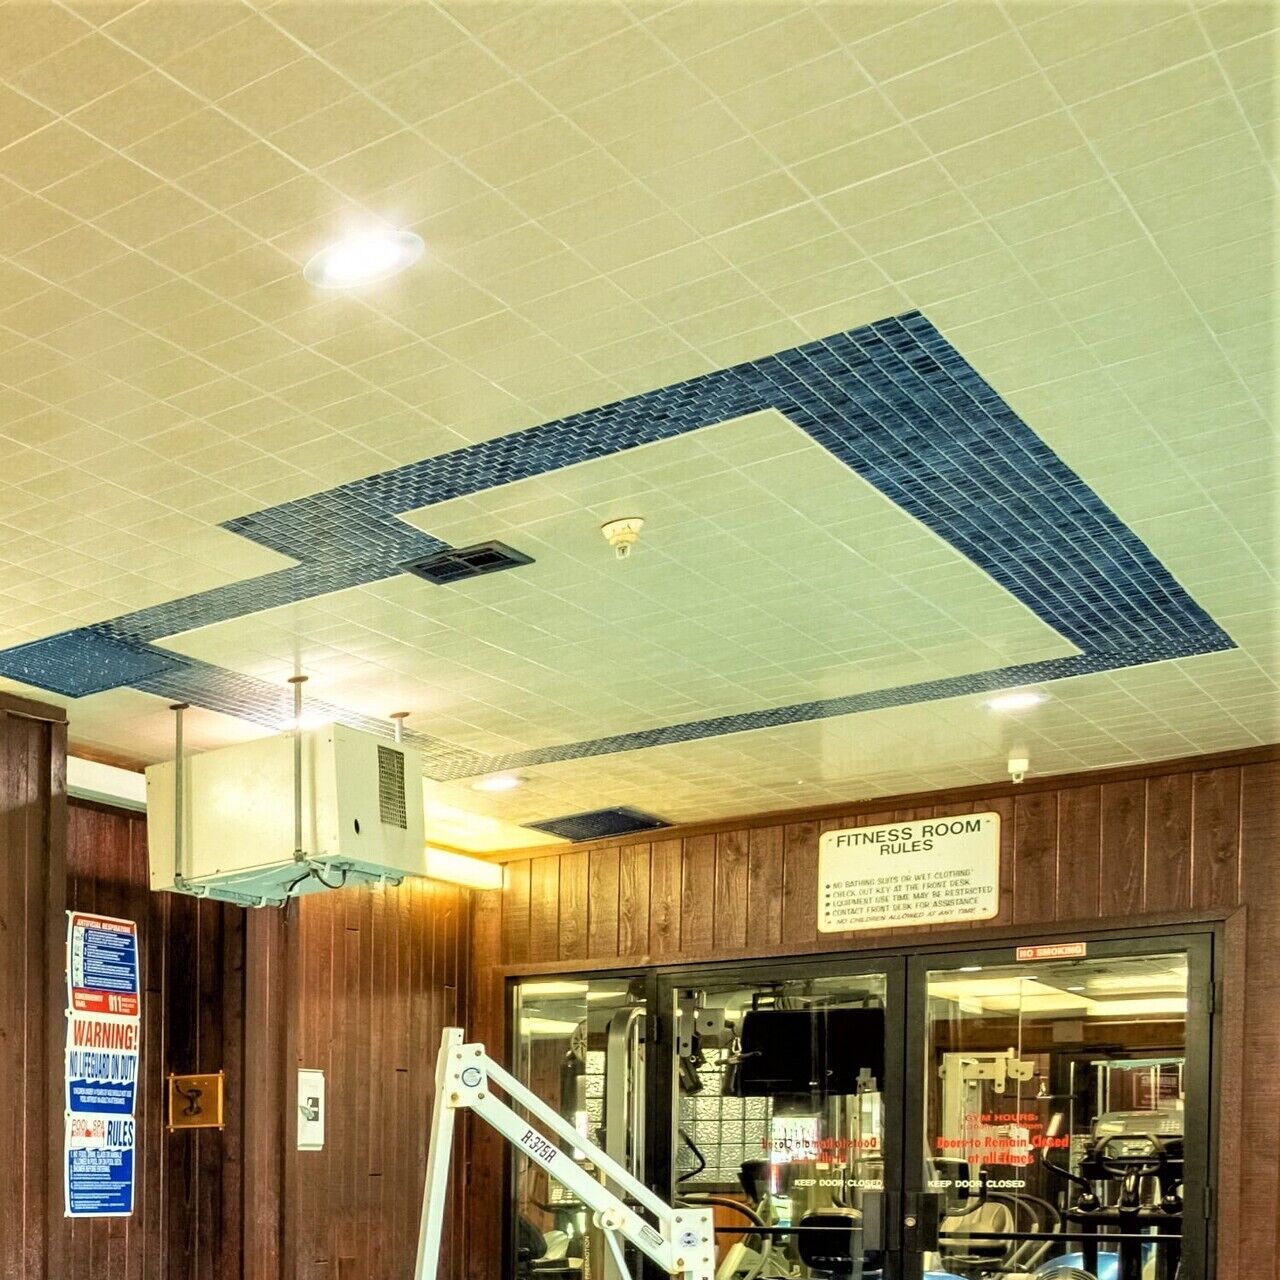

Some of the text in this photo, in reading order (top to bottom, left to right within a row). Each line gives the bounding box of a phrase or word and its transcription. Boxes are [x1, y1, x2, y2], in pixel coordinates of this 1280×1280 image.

[836, 819, 981, 848] FITNESS ROOM
[880, 839, 934, 856] RULES
[845, 879, 875, 888] BATHING
[877, 876, 898, 885] SUITS
[914, 873, 931, 881] WET
[934, 869, 971, 879] CLOTHING
[833, 890, 856, 898] CHECK
[859, 888, 873, 896] OUT
[876, 886, 890, 894] KEY
[922, 881, 947, 890] FRONT
[950, 879, 970, 887] DESK
[833, 886, 993, 907] EQUIPMENT USE TIME MAY BE RESTRICTED
[833, 897, 978, 916] CONTACT FRONT DESK FOR ASSISTANCE
[1019, 945, 1082, 958] NO SMOKING
[73, 1019, 138, 1051] WARNING!
[69, 1050, 137, 1081] NO LIFEGUARD ON DUTY
[106, 1120, 134, 1147] RULES
[984, 1135, 1027, 1149] Remain
[1032, 1134, 1069, 1149] Closed
[794, 1179, 883, 1188] KEEP DOOR CLOSED
[927, 1180, 1026, 1188] KEEP DOOR CLOSED
